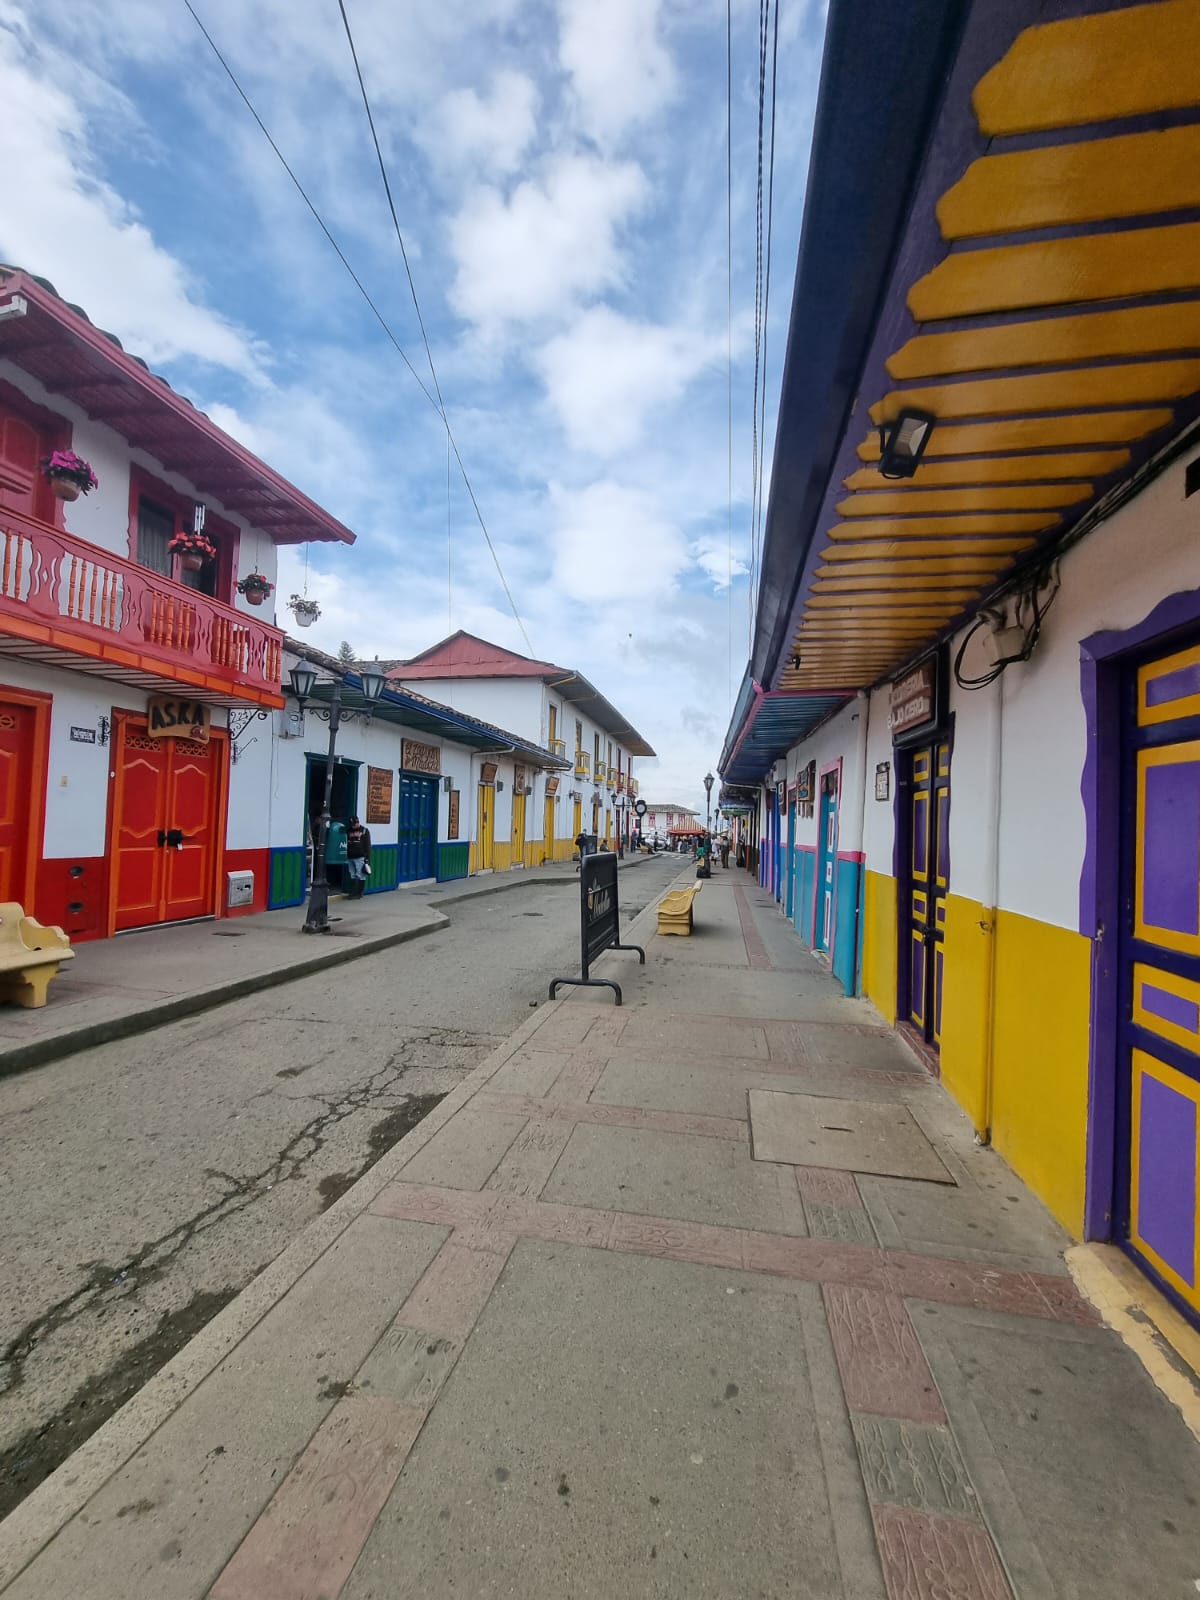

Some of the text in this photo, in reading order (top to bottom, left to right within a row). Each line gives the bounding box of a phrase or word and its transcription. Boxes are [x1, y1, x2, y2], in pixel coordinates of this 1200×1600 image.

[151, 702, 205, 730] ASKA
[888, 696, 924, 730] BAJO CERO
